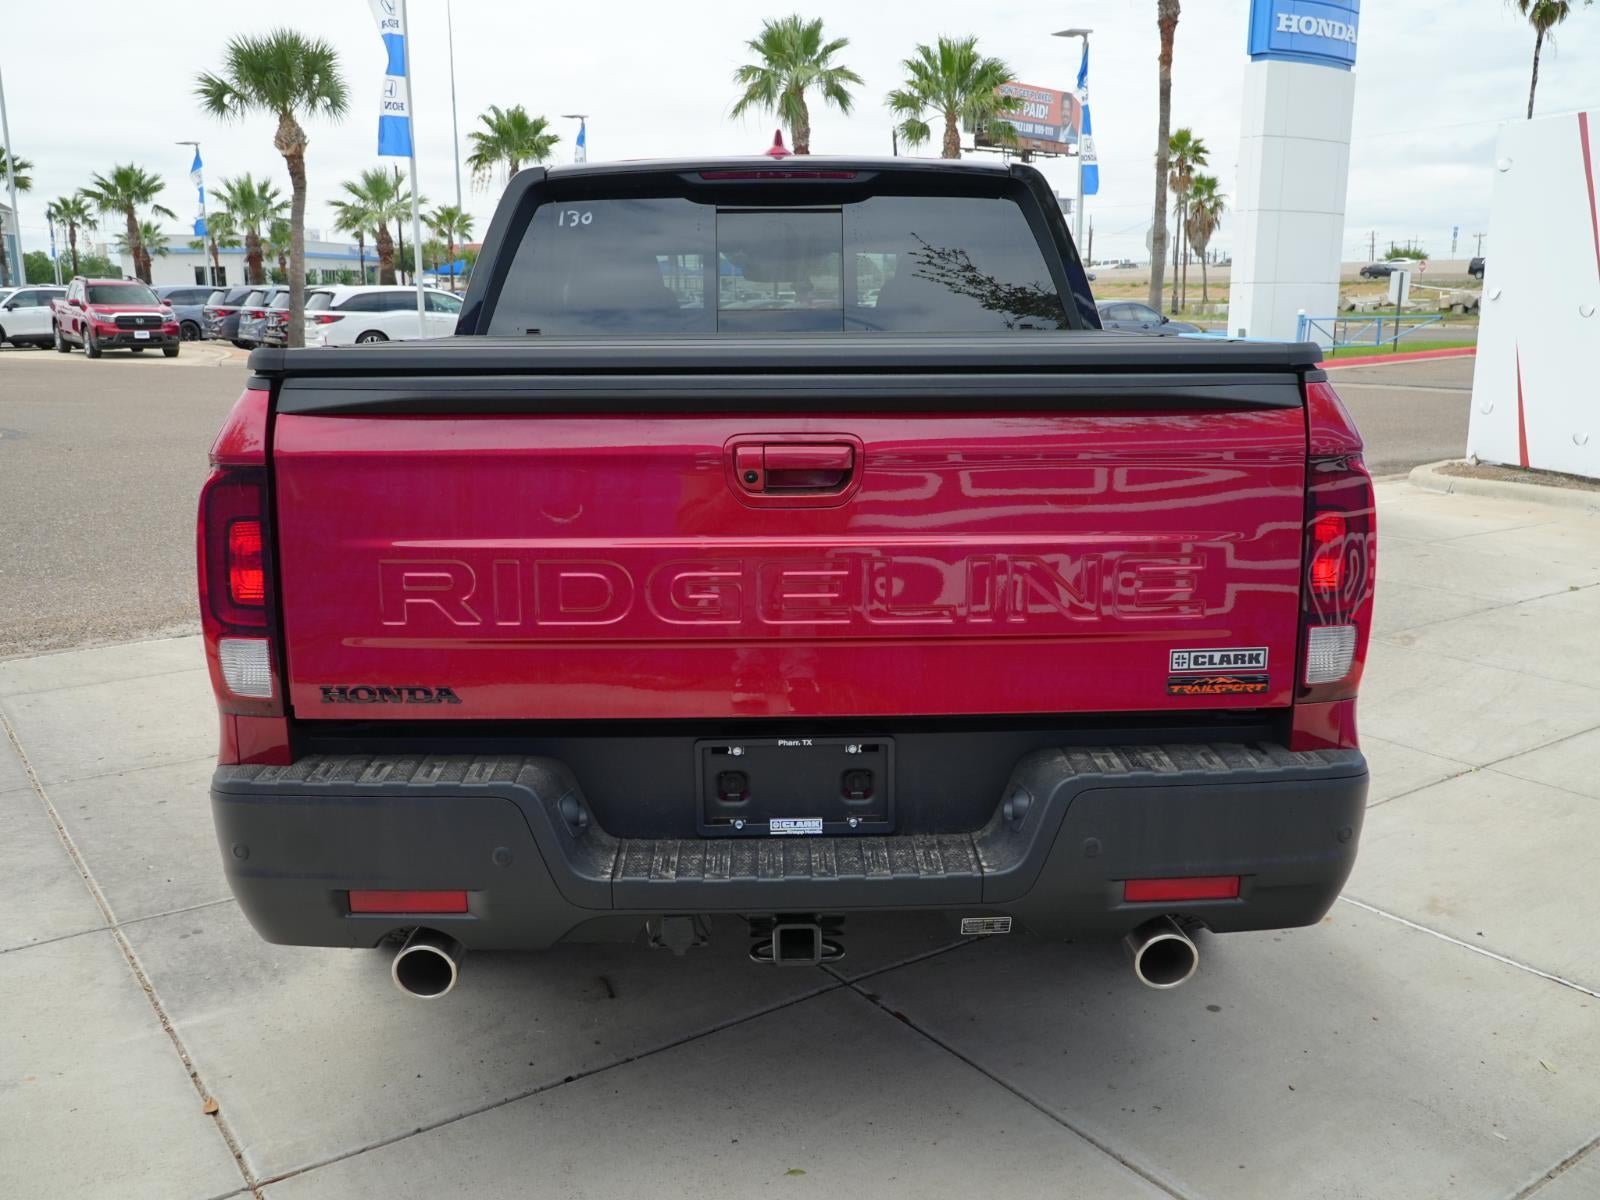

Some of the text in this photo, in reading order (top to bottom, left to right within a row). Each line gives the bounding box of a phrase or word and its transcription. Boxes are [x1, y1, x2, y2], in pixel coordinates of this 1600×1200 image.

[1276, 13, 1357, 44] HONDA
[1023, 102, 1049, 120] PAID!
[559, 210, 592, 227] 130
[378, 552, 1206, 626] RIDGELINE
[1193, 653, 1262, 666] CLARK
[319, 685, 463, 704] HONDA
[1170, 683, 1267, 694] TRAILSPORT
[781, 820, 820, 828] CLARK
